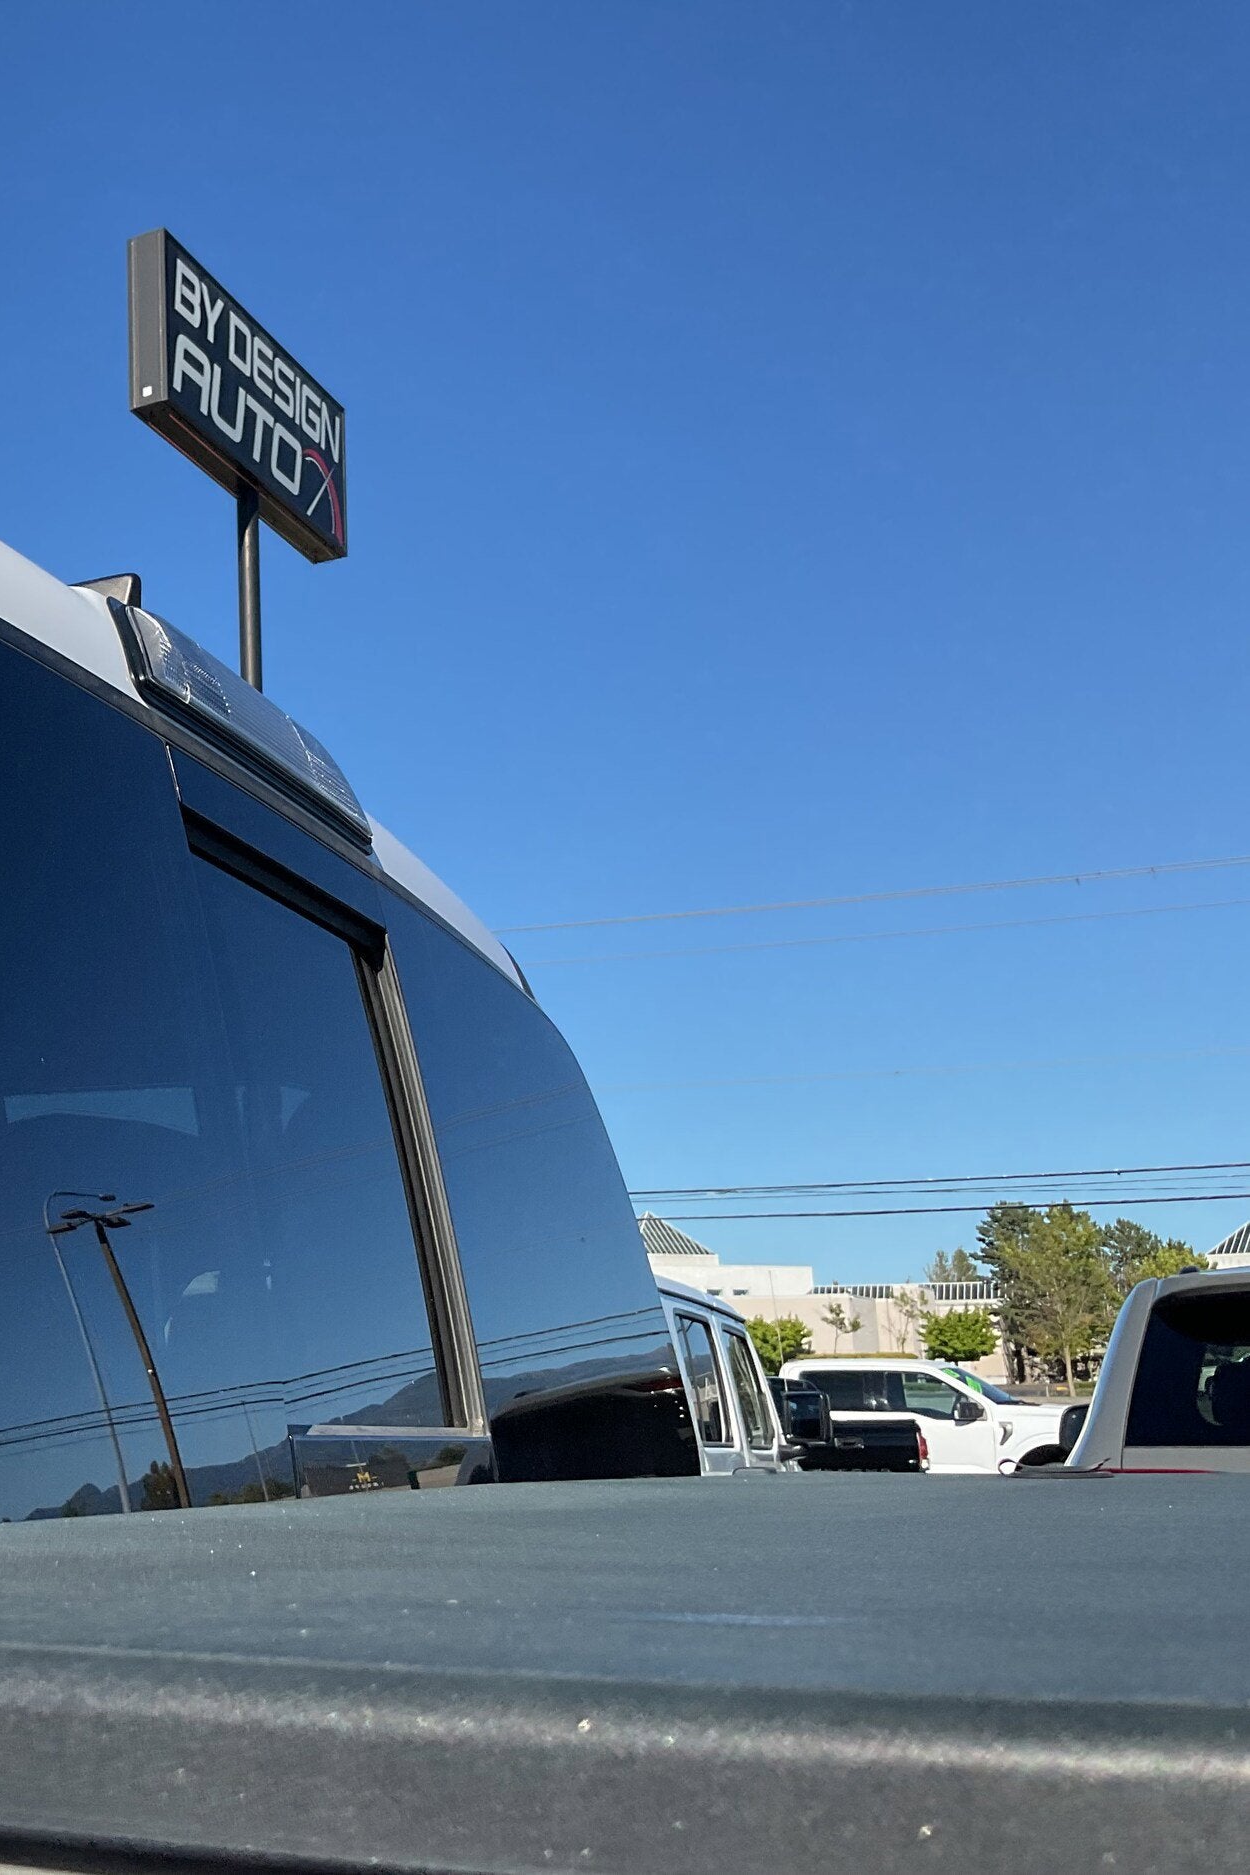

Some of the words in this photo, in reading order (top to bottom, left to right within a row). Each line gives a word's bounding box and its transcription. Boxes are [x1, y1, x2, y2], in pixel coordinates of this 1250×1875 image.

[172, 333, 302, 496] AUTO
[174, 257, 224, 343] BY
[228, 310, 340, 464] DESIGN
